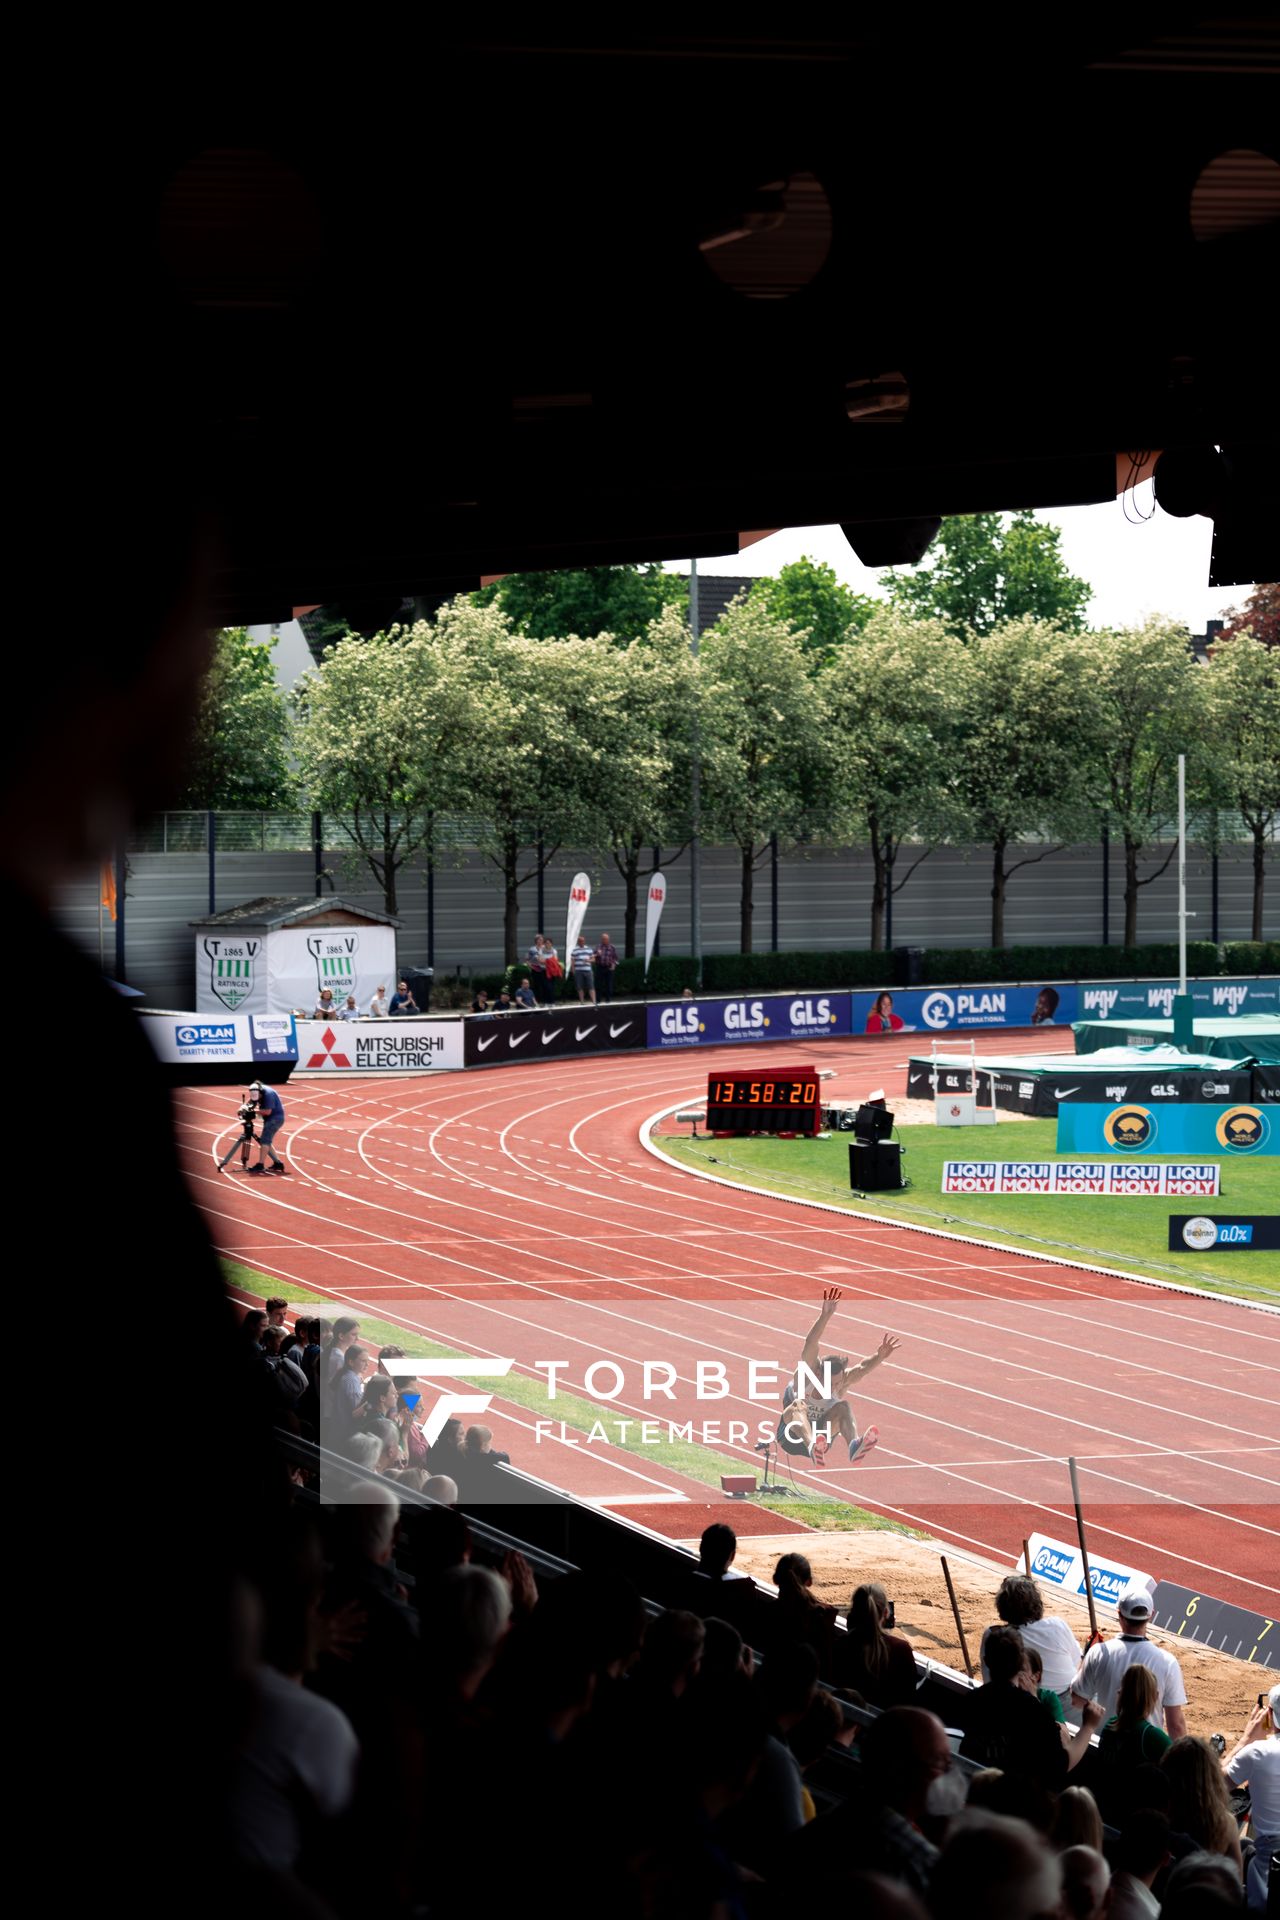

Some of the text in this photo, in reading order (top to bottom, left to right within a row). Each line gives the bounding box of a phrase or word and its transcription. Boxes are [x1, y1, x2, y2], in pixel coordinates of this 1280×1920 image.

[572, 888, 586, 902] ABB
[650, 888, 663, 902] ABB
[211, 941, 257, 956] T V
[224, 949, 243, 957] 1865
[313, 938, 354, 954] T V
[326, 946, 343, 954] 1865
[957, 993, 1006, 1014] PLAN
[957, 1015, 1006, 1024] INTERNATIONAL
[200, 1028, 233, 1038] PLAN
[356, 1037, 444, 1052] MITSUBISHI
[356, 1053, 432, 1067] ELECTRIC
[715, 1083, 816, 1103] 13:58:20
[950, 1165, 995, 1178] LIQUI
[1003, 1165, 1049, 1178] LIQUI
[1058, 1165, 1104, 1179] LIQUI
[1113, 1166, 1159, 1179] LIQUI
[1168, 1166, 1214, 1180] LIQUI
[948, 1178, 994, 1191] MOLY
[1002, 1179, 1049, 1192] MOLY
[1056, 1179, 1104, 1192] MOLY
[1111, 1180, 1158, 1193] MOLY
[1166, 1181, 1214, 1194] MOLY
[1048, 1556, 1071, 1573] PLAN
[1098, 1575, 1128, 1593] PLAN
[1186, 1596, 1200, 1617] 6
[1257, 1620, 1274, 1641] 7
